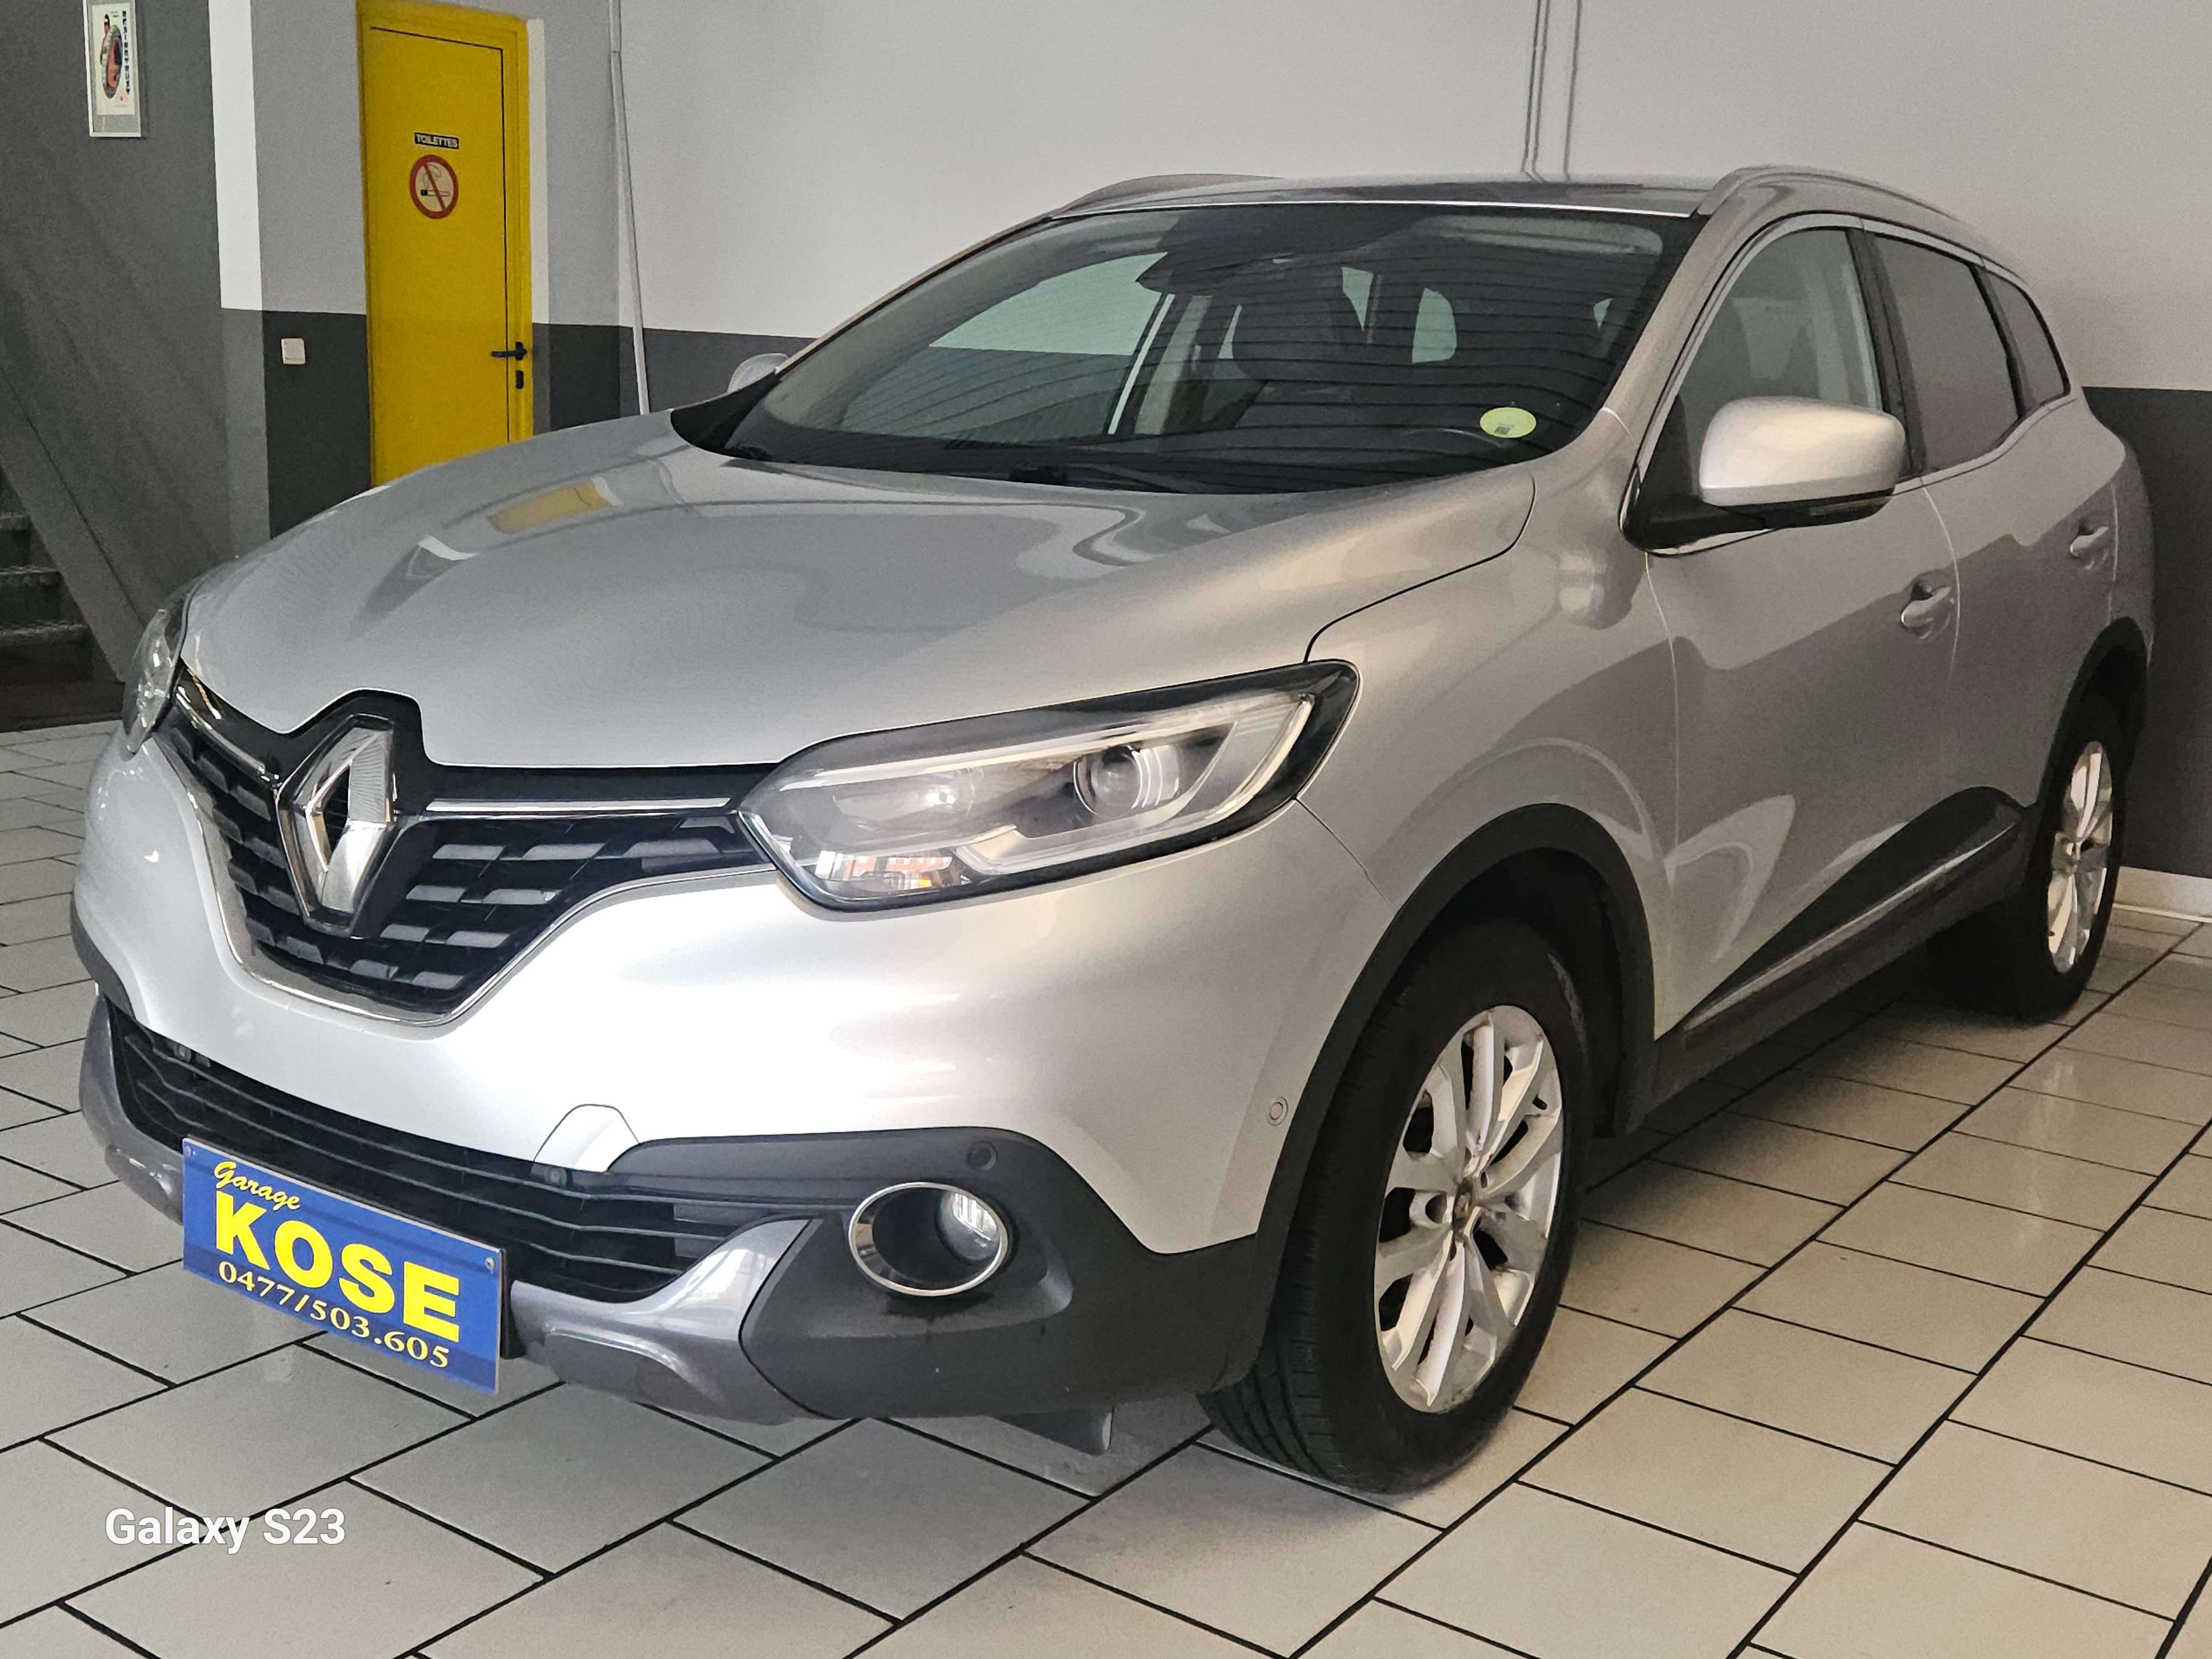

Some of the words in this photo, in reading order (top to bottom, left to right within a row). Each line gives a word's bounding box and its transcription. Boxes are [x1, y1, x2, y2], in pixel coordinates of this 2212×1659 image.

[416, 134, 457, 148] TOILETTES
[214, 1161, 300, 1210] Garage
[216, 1191, 459, 1343] KOSE
[218, 1261, 450, 1368] 0477/503.605
